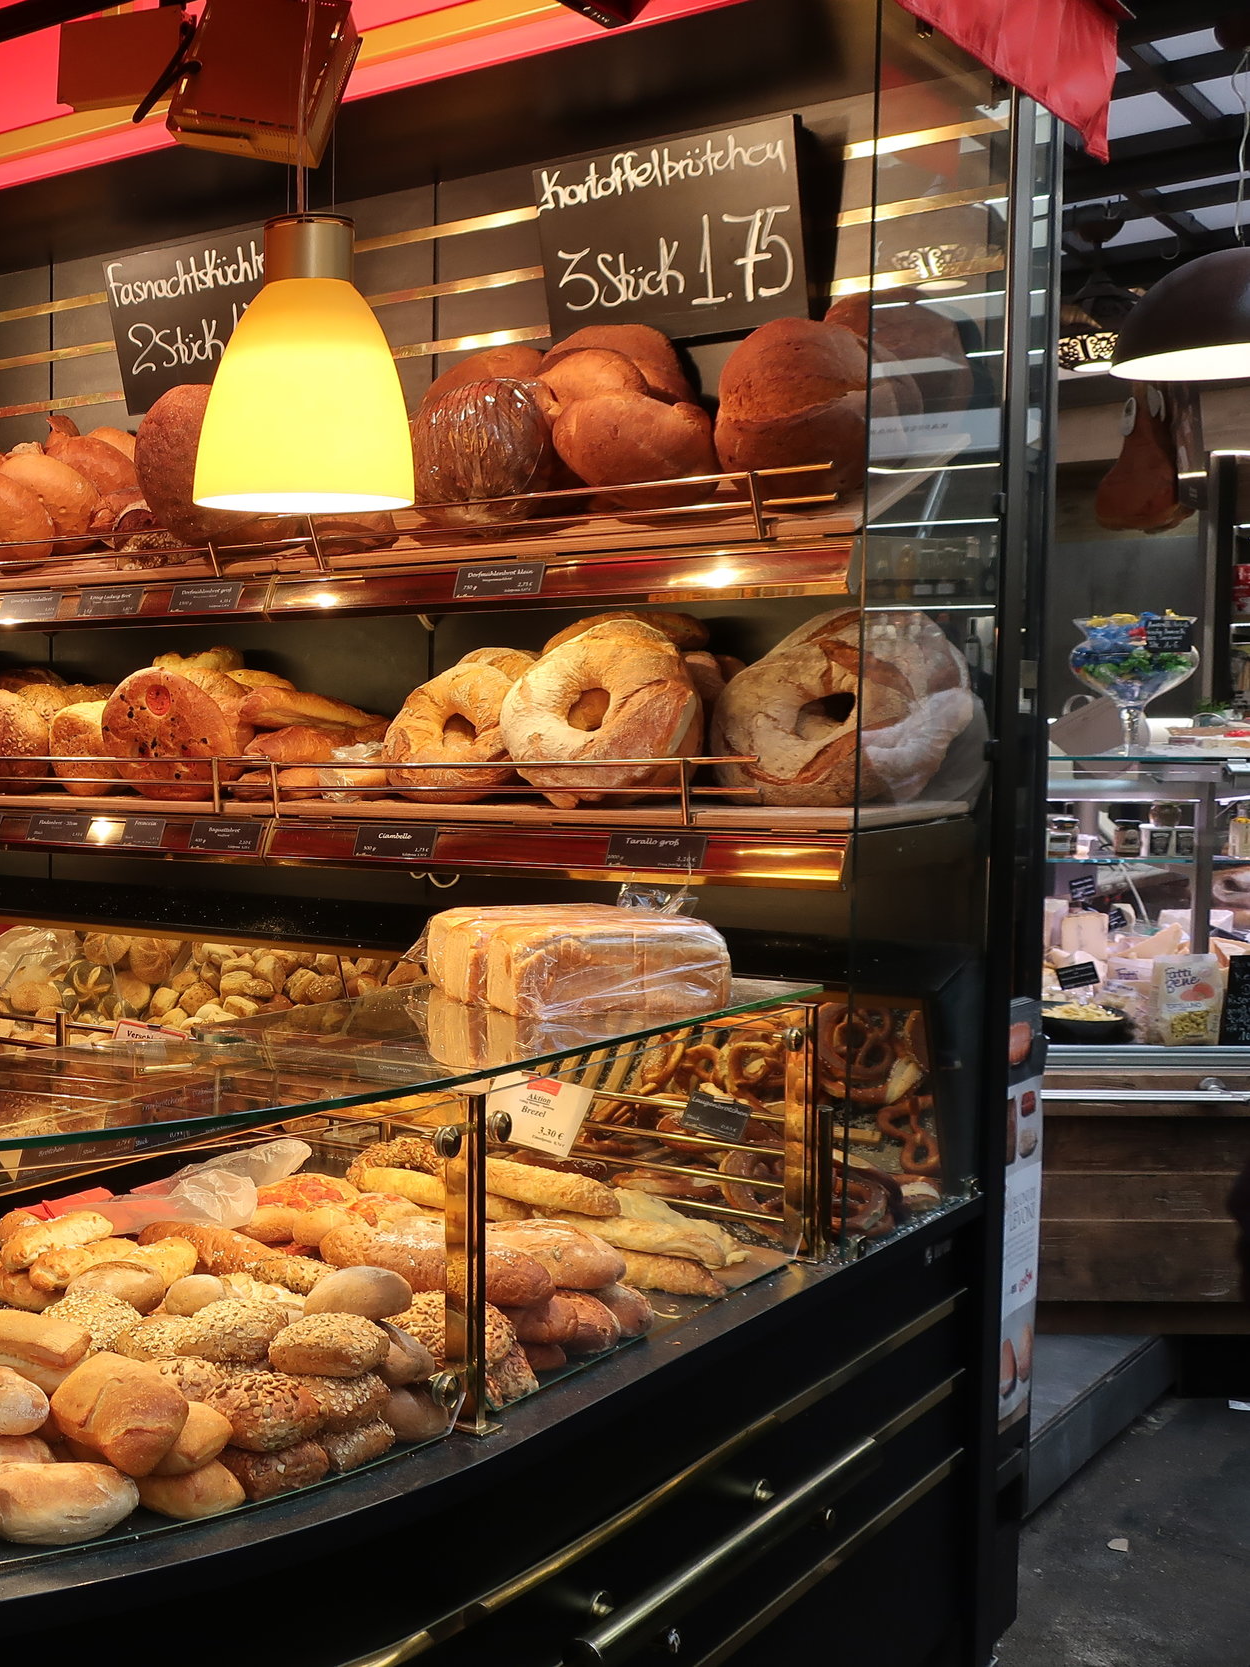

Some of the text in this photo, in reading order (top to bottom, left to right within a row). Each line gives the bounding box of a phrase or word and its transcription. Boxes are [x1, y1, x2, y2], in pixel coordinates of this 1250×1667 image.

[378, 832, 413, 840] Ciambelle
[626, 837, 658, 846] Tarallo
[527, 1093, 552, 1105] Aktion
[521, 1105, 547, 1118] Brezel
[557, 1132, 565, 1141] €
